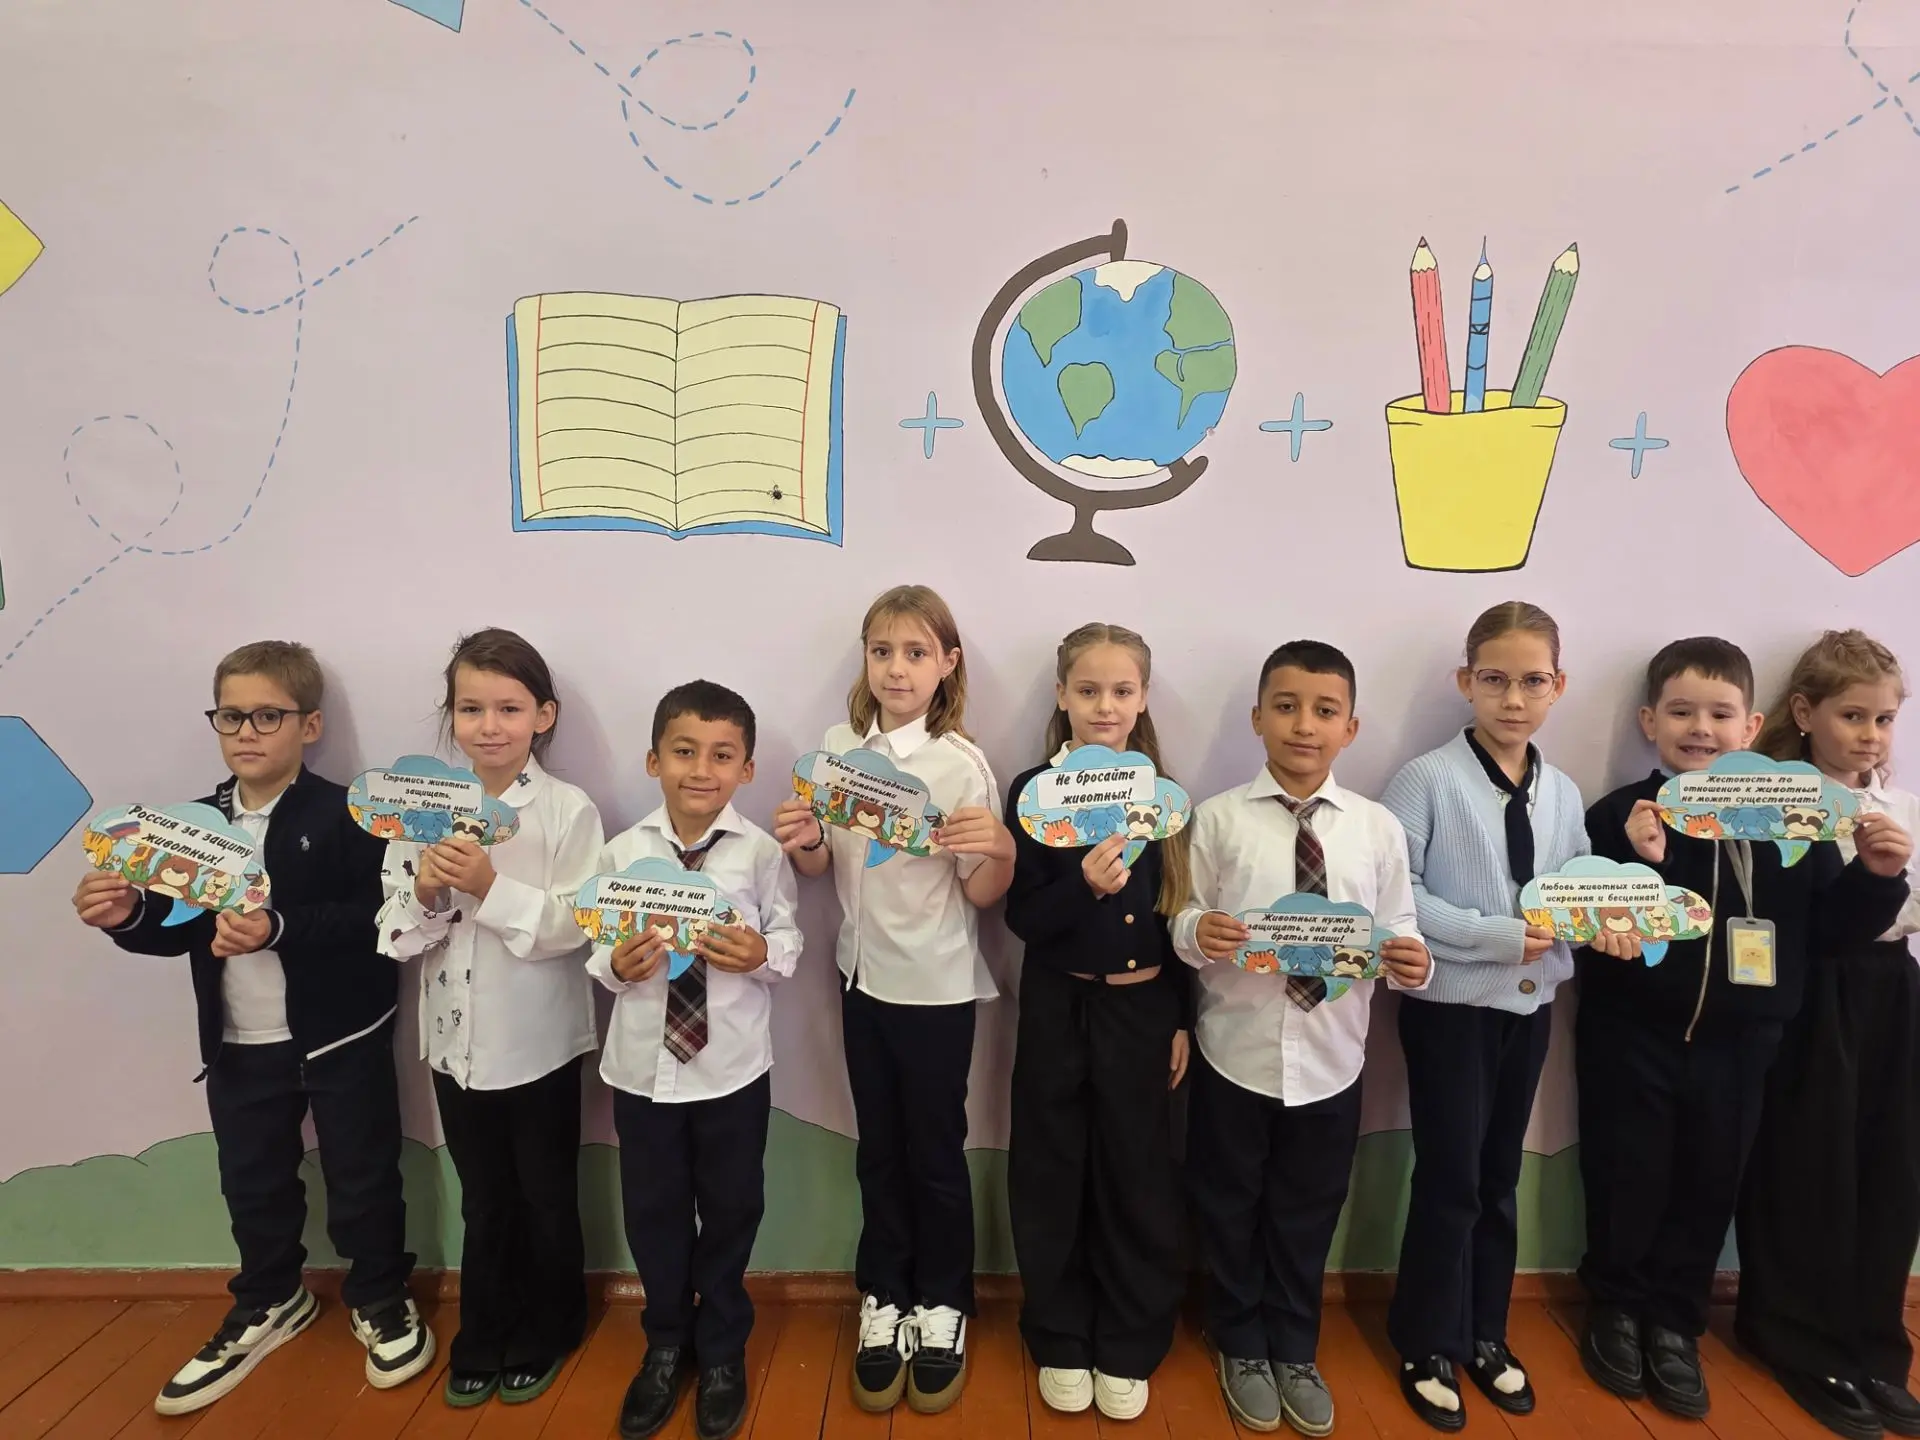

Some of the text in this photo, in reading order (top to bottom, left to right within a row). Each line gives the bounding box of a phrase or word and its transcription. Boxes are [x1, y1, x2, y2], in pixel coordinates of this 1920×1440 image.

[383, 773, 470, 789] Стремись животных
[826, 757, 919, 796] Будьте милосердными
[1056, 769, 1135, 786] Не бросайте
[405, 789, 451, 799] защищать,
[850, 780, 897, 798] гуманными
[1061, 788, 1132, 805] животных!
[422, 801, 450, 809] братья
[454, 806, 477, 814] наши!
[832, 785, 880, 805] животному
[883, 802, 908, 816] миру!
[1736, 795, 1822, 805] существовать!
[129, 806, 253, 858] Россия за защиту
[142, 833, 224, 866] животных!
[608, 881, 641, 892] Кроме
[646, 886, 666, 896] нас,
[688, 892, 706, 900] них
[1540, 883, 1574, 891] Любовь
[598, 897, 714, 916] некому заступиться!
[1546, 895, 1594, 903] искренняя
[1608, 893, 1659, 903] бесценная!
[1262, 914, 1354, 925] Животных нужно
[1271, 933, 1344, 943] братья наши!
